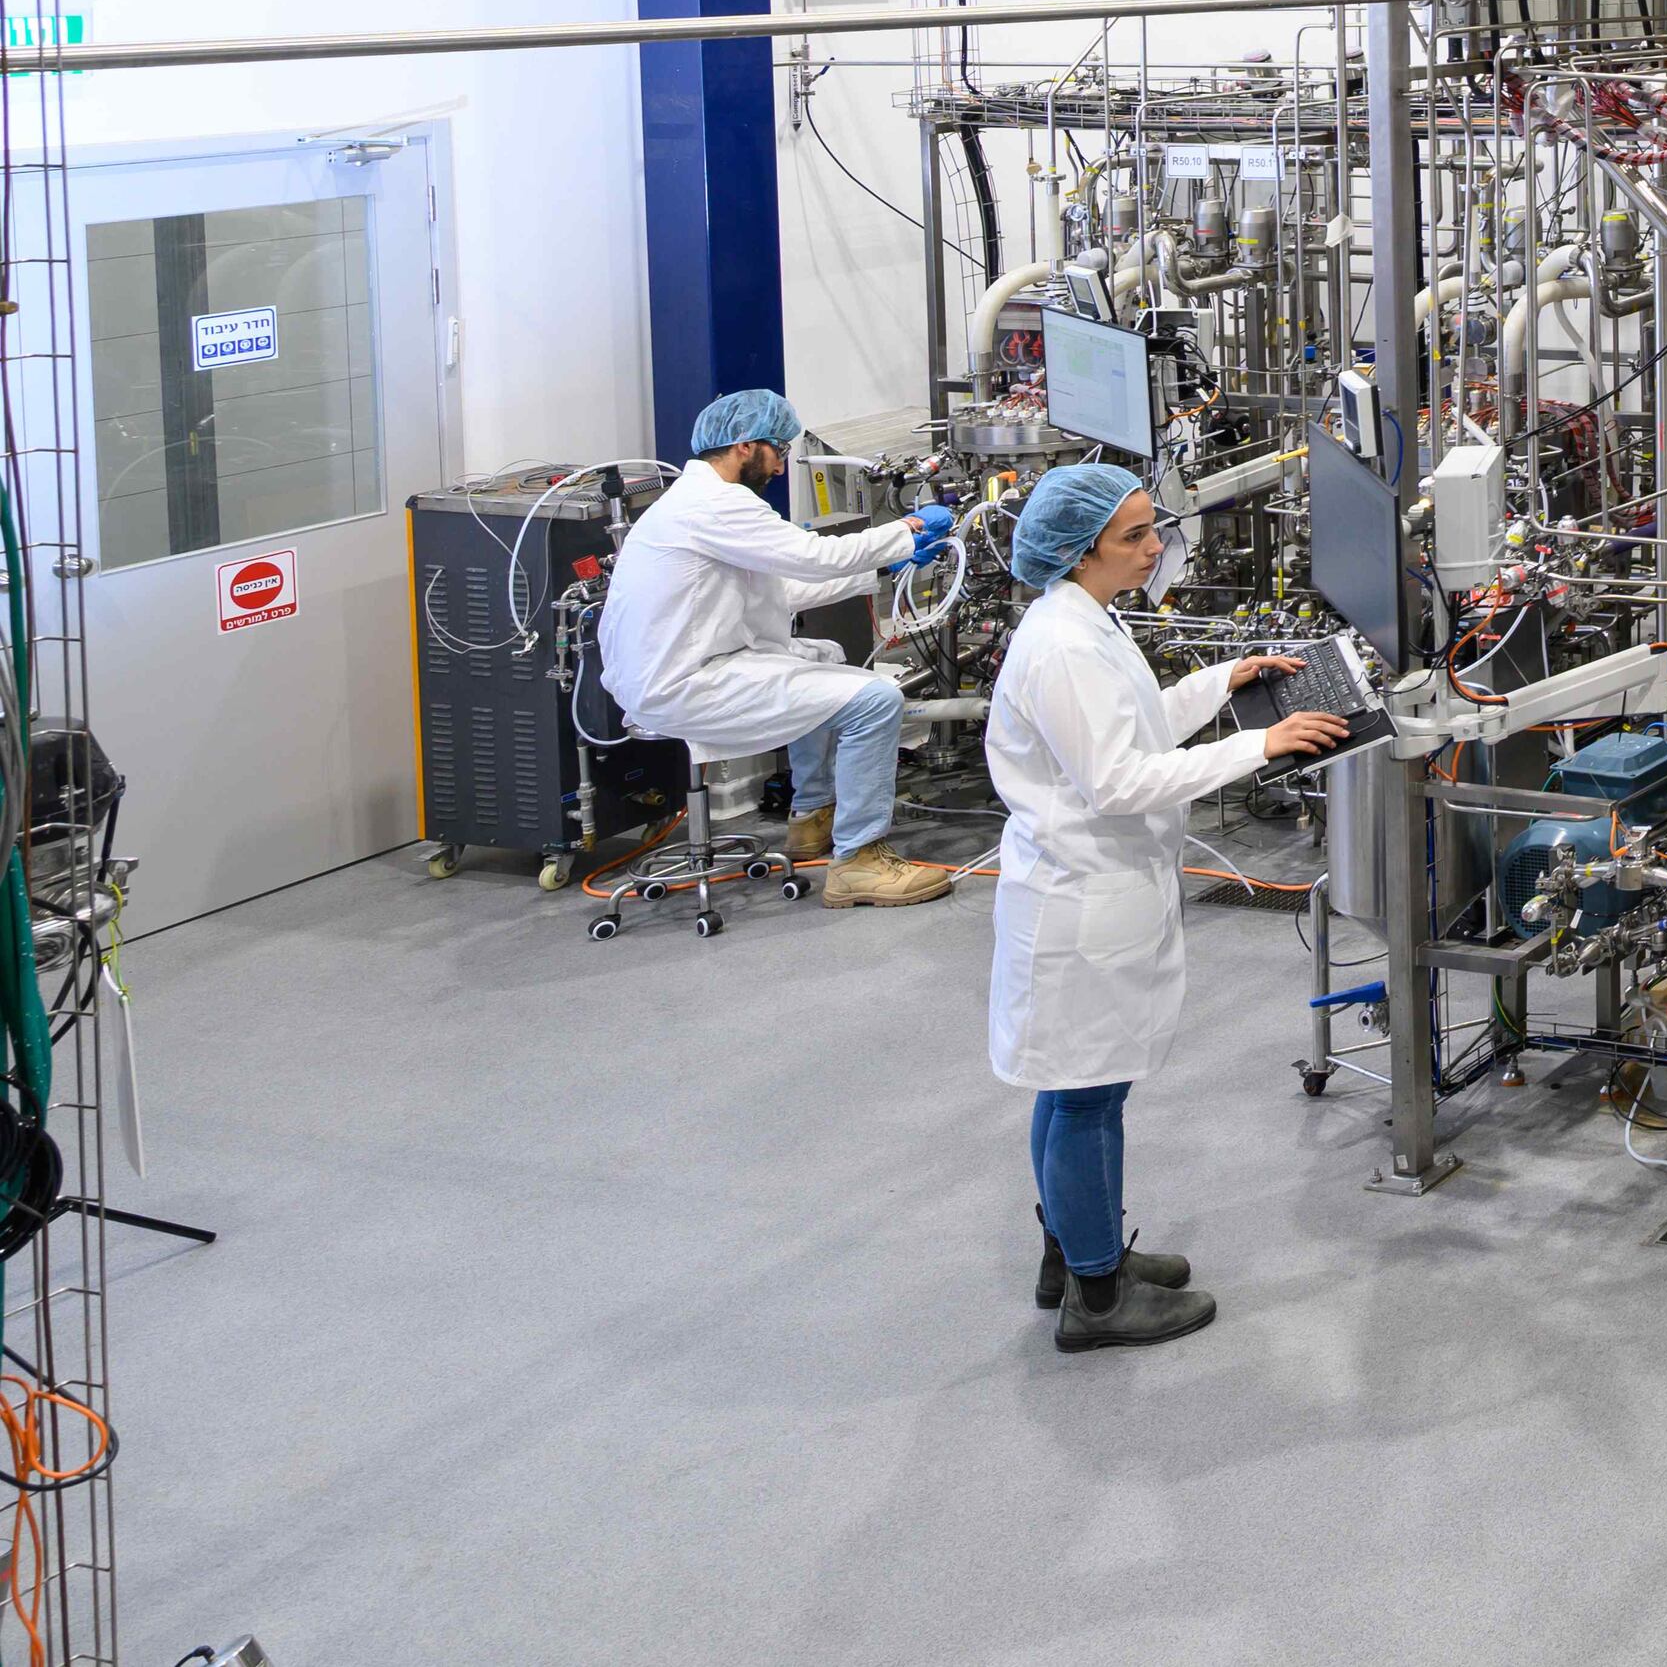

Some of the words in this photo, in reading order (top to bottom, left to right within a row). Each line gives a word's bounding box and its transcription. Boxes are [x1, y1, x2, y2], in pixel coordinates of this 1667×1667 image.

[792, 74, 800, 120] Compssed
[1172, 156, 1202, 167] R50.10
[1247, 158, 1276, 168] R50.1
[201, 322, 239, 336] עיבוד
[243, 318, 270, 330] חדר
[235, 581, 263, 593] כניסה
[265, 577, 278, 588] אין
[271, 607, 292, 618] פרט
[226, 611, 269, 629] למורשים
